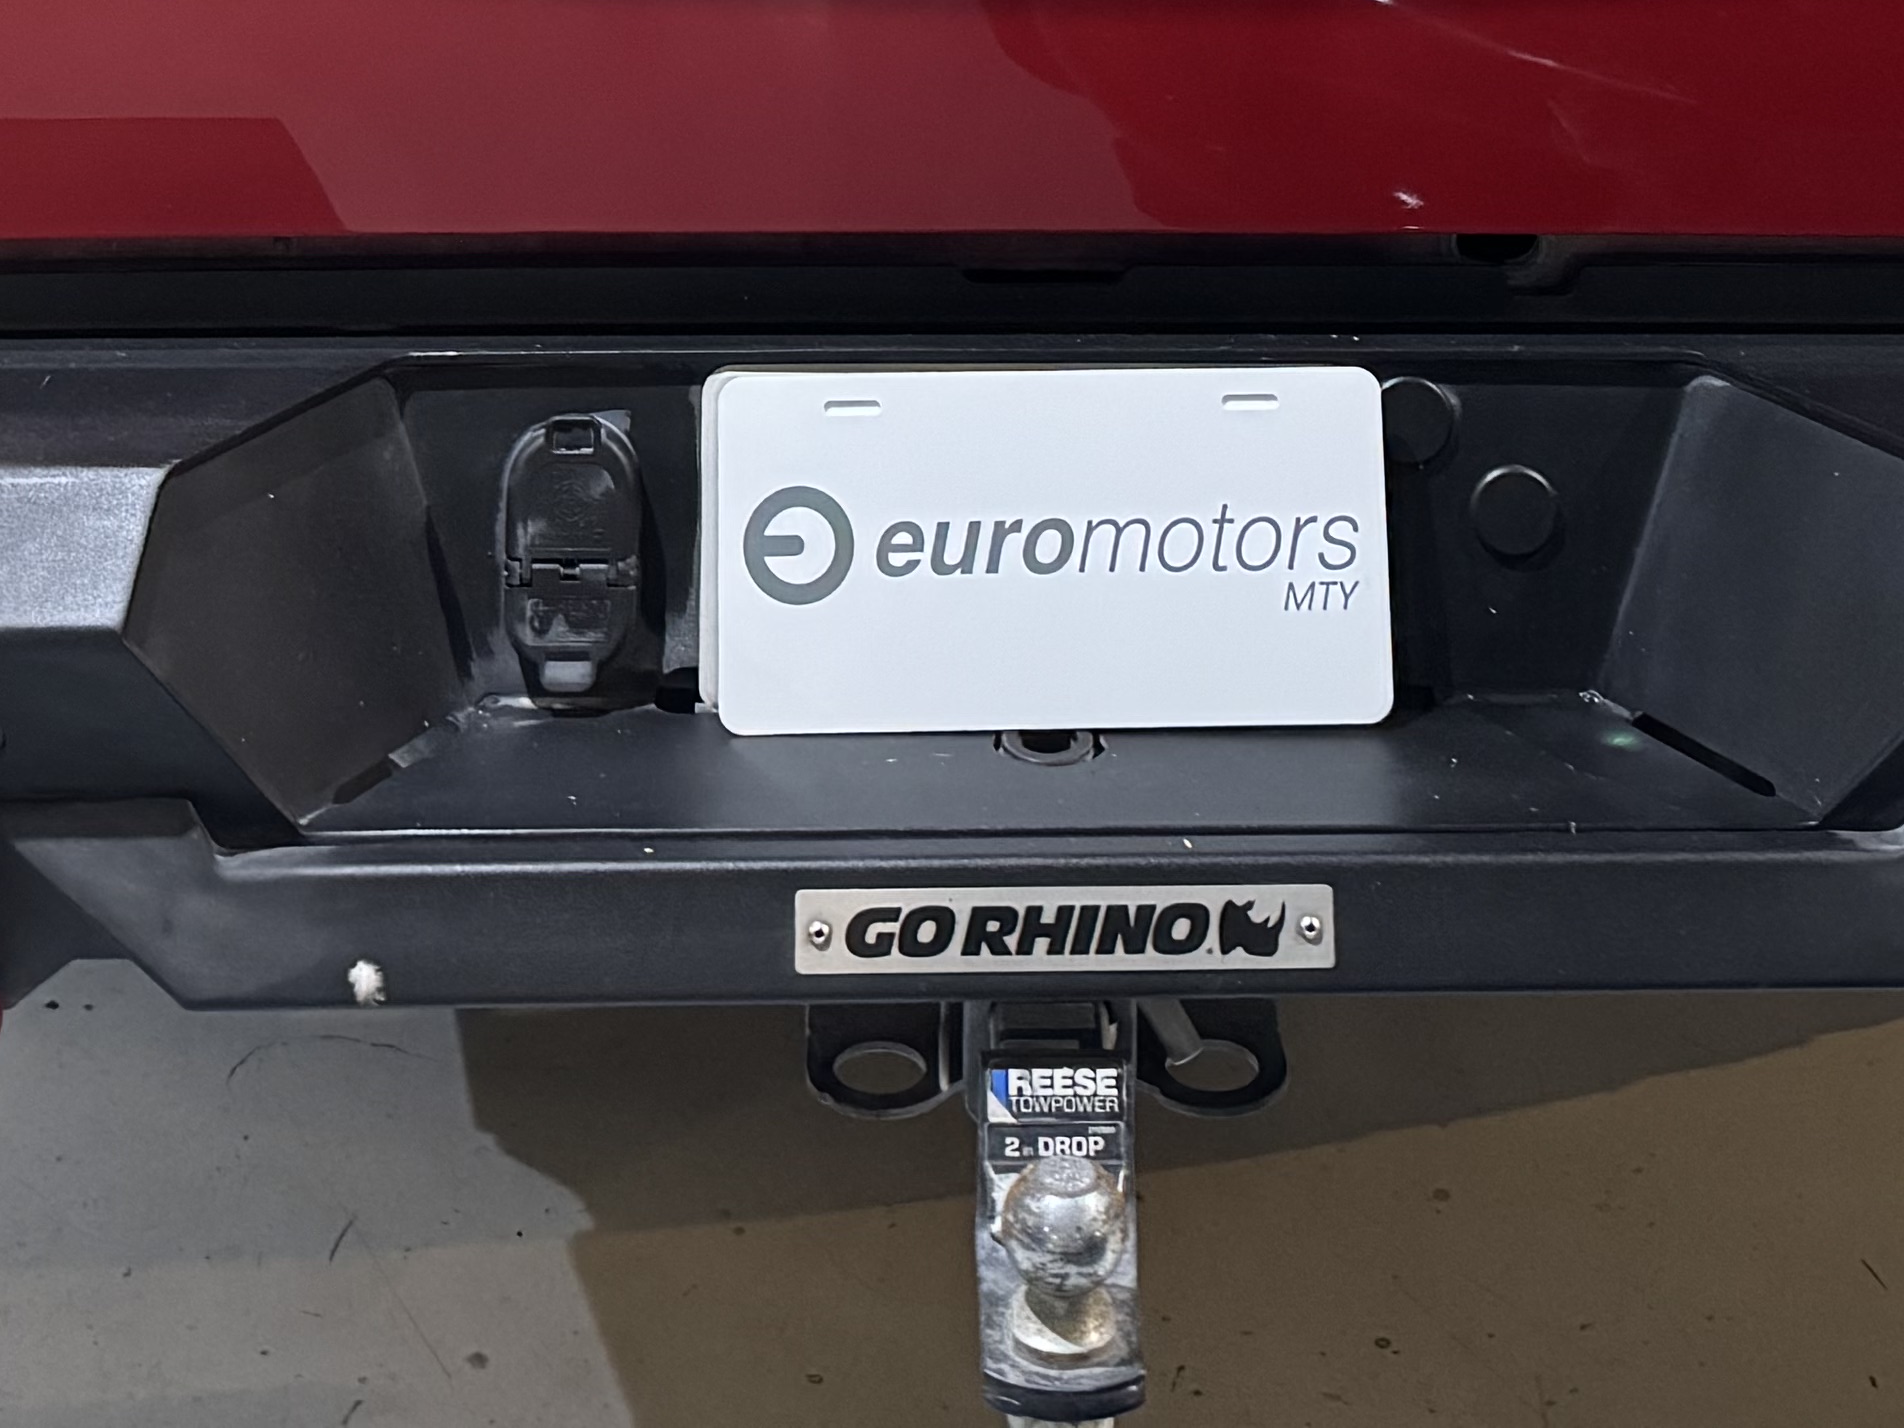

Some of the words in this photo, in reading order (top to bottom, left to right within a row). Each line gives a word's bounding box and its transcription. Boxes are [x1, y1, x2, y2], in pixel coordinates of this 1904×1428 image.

[875, 503, 1360, 577] euromotors
[1284, 581, 1360, 613] MTY
[845, 905, 956, 959] GO
[960, 902, 1211, 958] RHINO
[1007, 1067, 1119, 1096] REESE
[1008, 1096, 1120, 1113] TOWPOWER
[1004, 1137, 1021, 1157] 2
[1037, 1136, 1106, 1157] DROP
